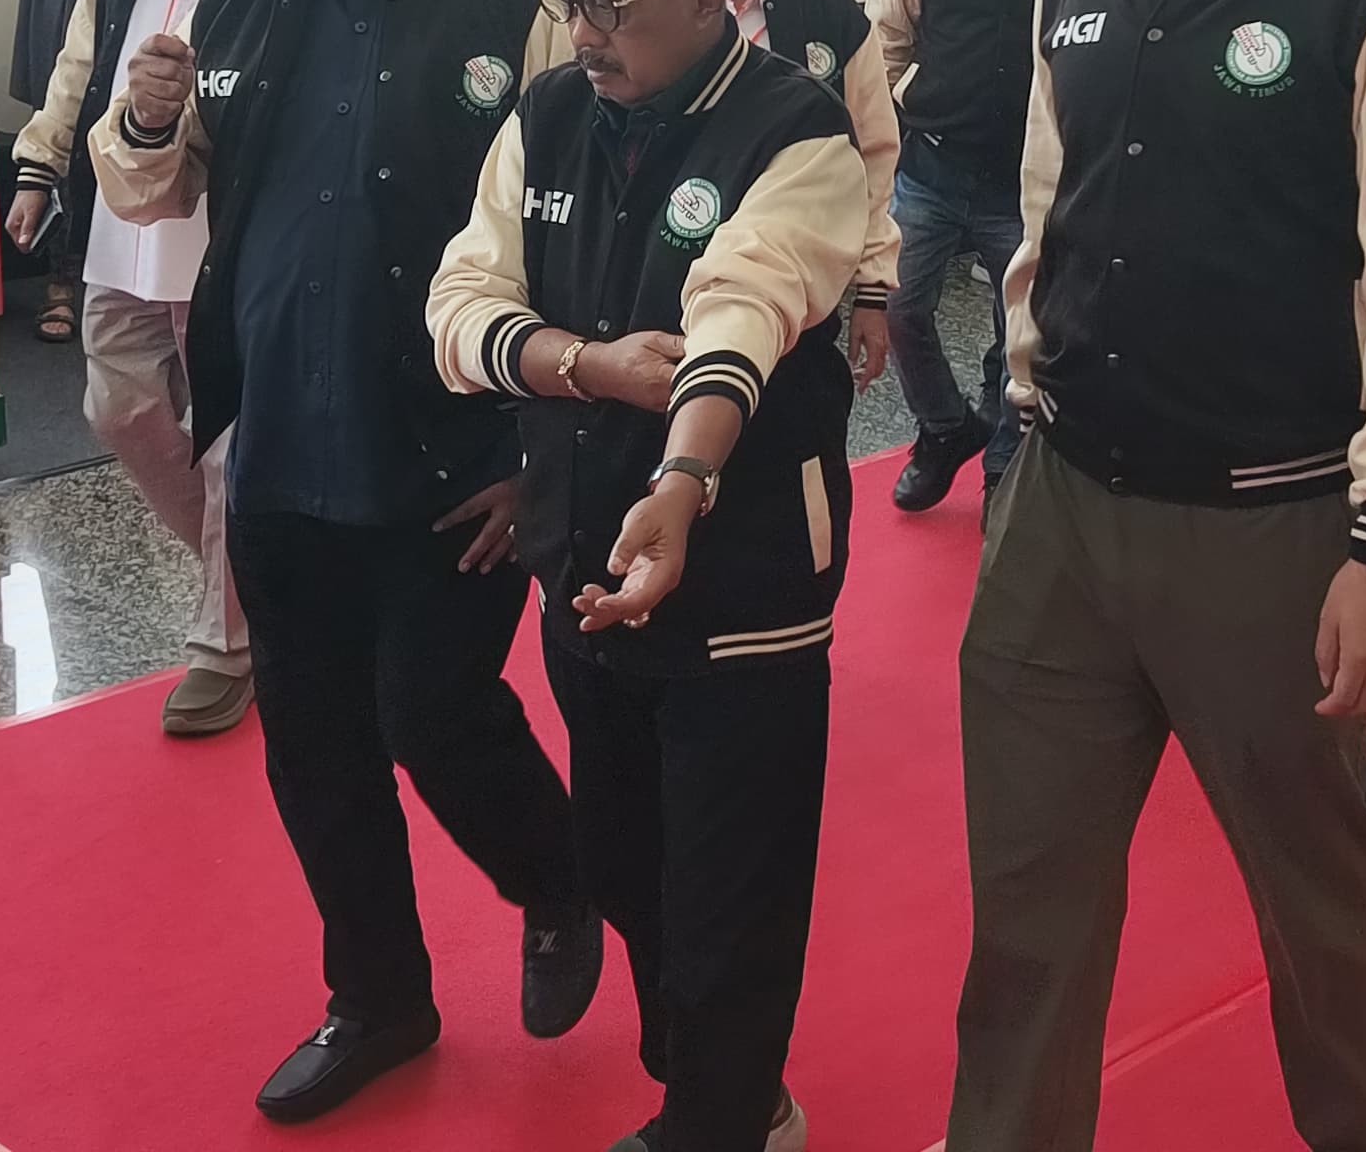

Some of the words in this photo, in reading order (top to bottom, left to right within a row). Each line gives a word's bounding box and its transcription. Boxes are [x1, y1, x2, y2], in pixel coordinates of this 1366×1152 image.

[1051, 12, 1107, 49] HGI
[197, 69, 241, 98] HGI
[1213, 63, 1242, 95] JAWA
[522, 186, 575, 225] HGI
[659, 228, 691, 251] JAWA
